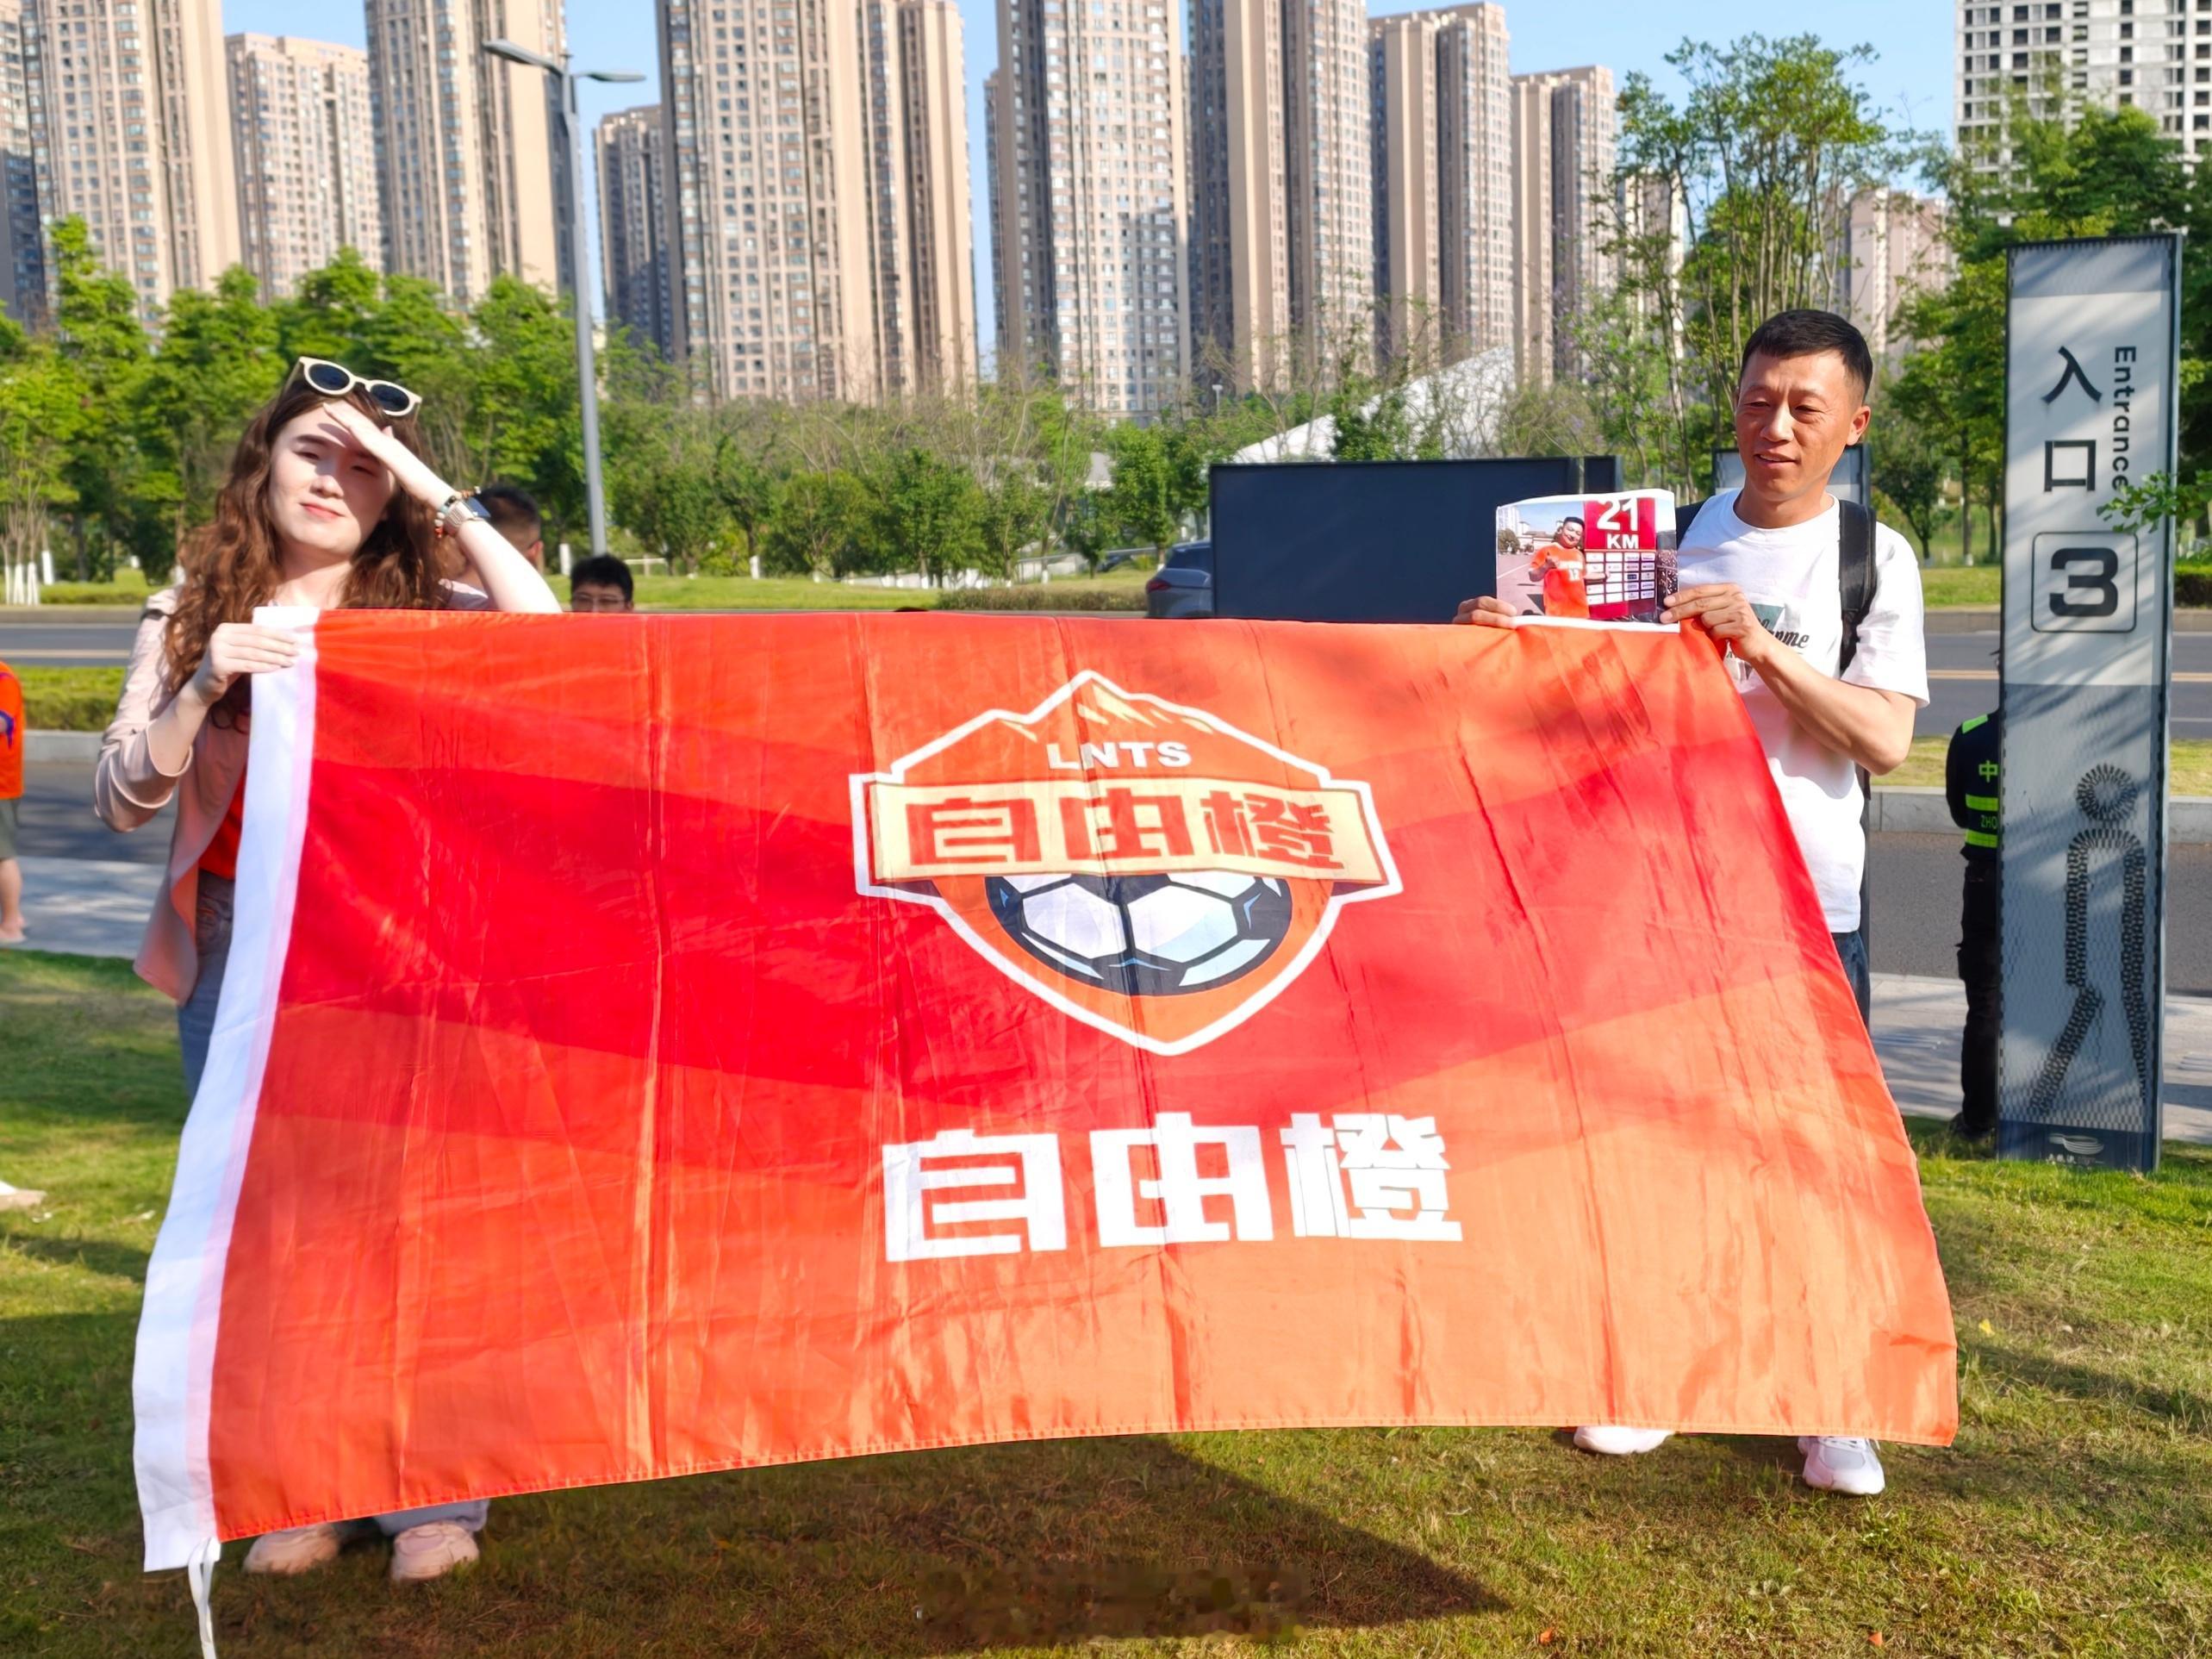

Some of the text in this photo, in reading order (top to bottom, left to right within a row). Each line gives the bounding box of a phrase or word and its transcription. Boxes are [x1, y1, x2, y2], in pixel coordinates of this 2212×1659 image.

[2041, 346, 2103, 493] 入口
[2111, 346, 2136, 490] Entrance
[1597, 497, 1639, 532] 21
[1607, 533, 1639, 550] KM
[2049, 547, 2119, 618] 3
[1047, 740, 1193, 770] LNTS
[1978, 759, 1999, 783] 中
[905, 786, 1346, 870] 自由橙
[882, 1111, 1463, 1263] 自由橙
